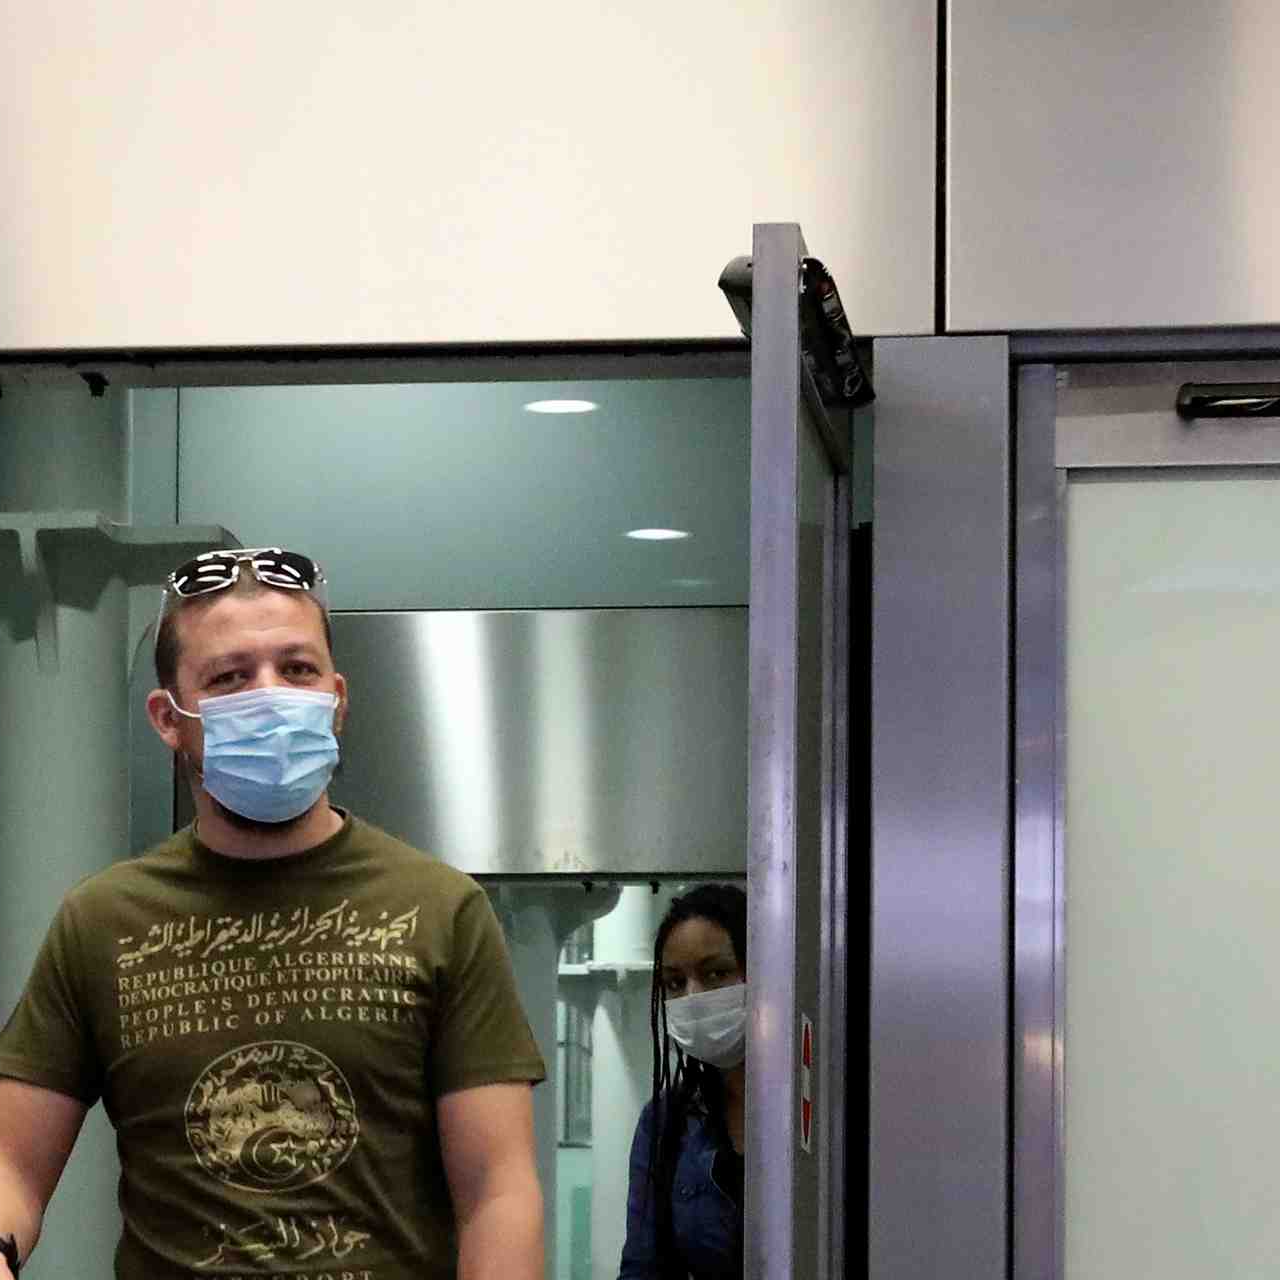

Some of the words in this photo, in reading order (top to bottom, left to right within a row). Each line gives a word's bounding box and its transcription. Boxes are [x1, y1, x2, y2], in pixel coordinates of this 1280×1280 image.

[116, 921, 175, 969] الشعبية
[258, 898, 350, 951] الجزائرية
[341, 905, 420, 951] الجمهورية
[118, 957, 257, 991] REPUBLIQUE
[269, 951, 417, 968] ALGERIENNE
[118, 972, 271, 1008] DEMOCRATIQUE
[302, 967, 417, 985] POPULAIRE
[120, 996, 233, 1029] PEOPLE'S
[247, 987, 417, 1008] DEMOCRATIC
[120, 1014, 240, 1049] REPUBLIC
[255, 1009, 287, 1026] OF
[300, 1005, 416, 1024] ALGERIA
